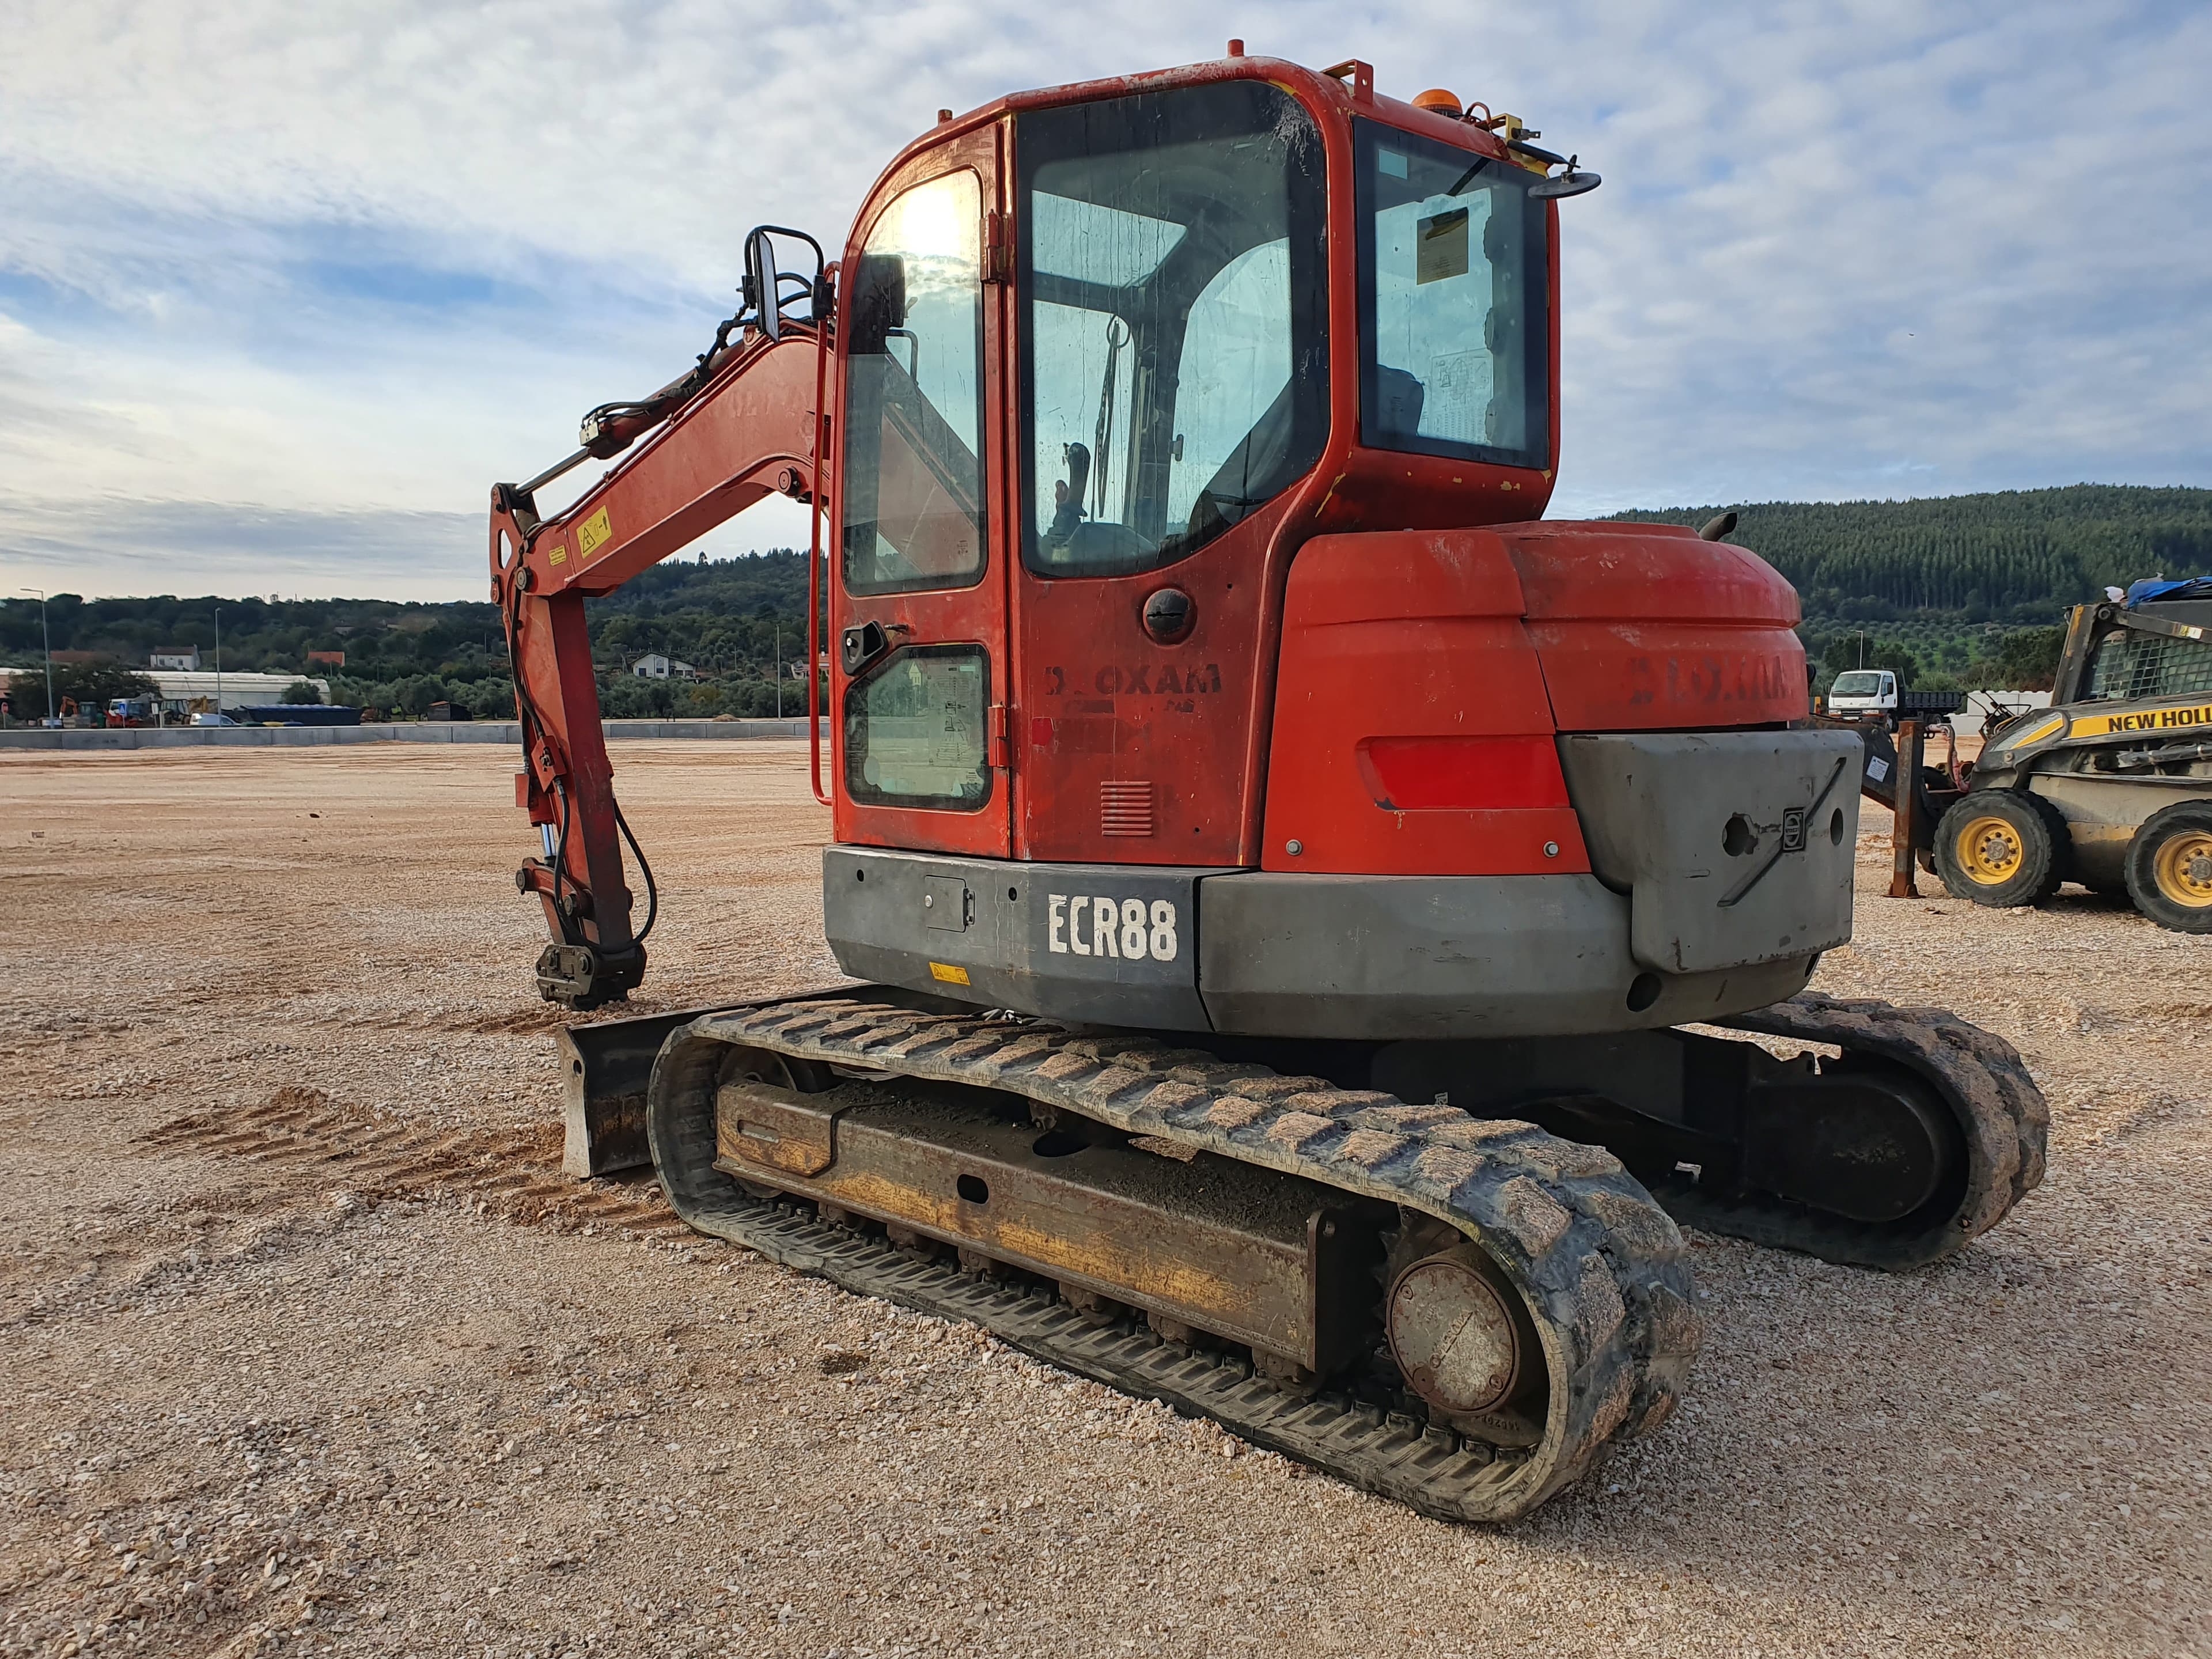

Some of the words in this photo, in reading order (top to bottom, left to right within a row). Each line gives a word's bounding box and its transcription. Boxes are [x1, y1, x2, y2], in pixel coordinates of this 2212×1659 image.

[1073, 663, 1222, 695] OXAM
[2108, 713, 2156, 732] NEW
[2161, 707, 2212, 727] HOLL
[1048, 893, 1177, 962] ECR88
